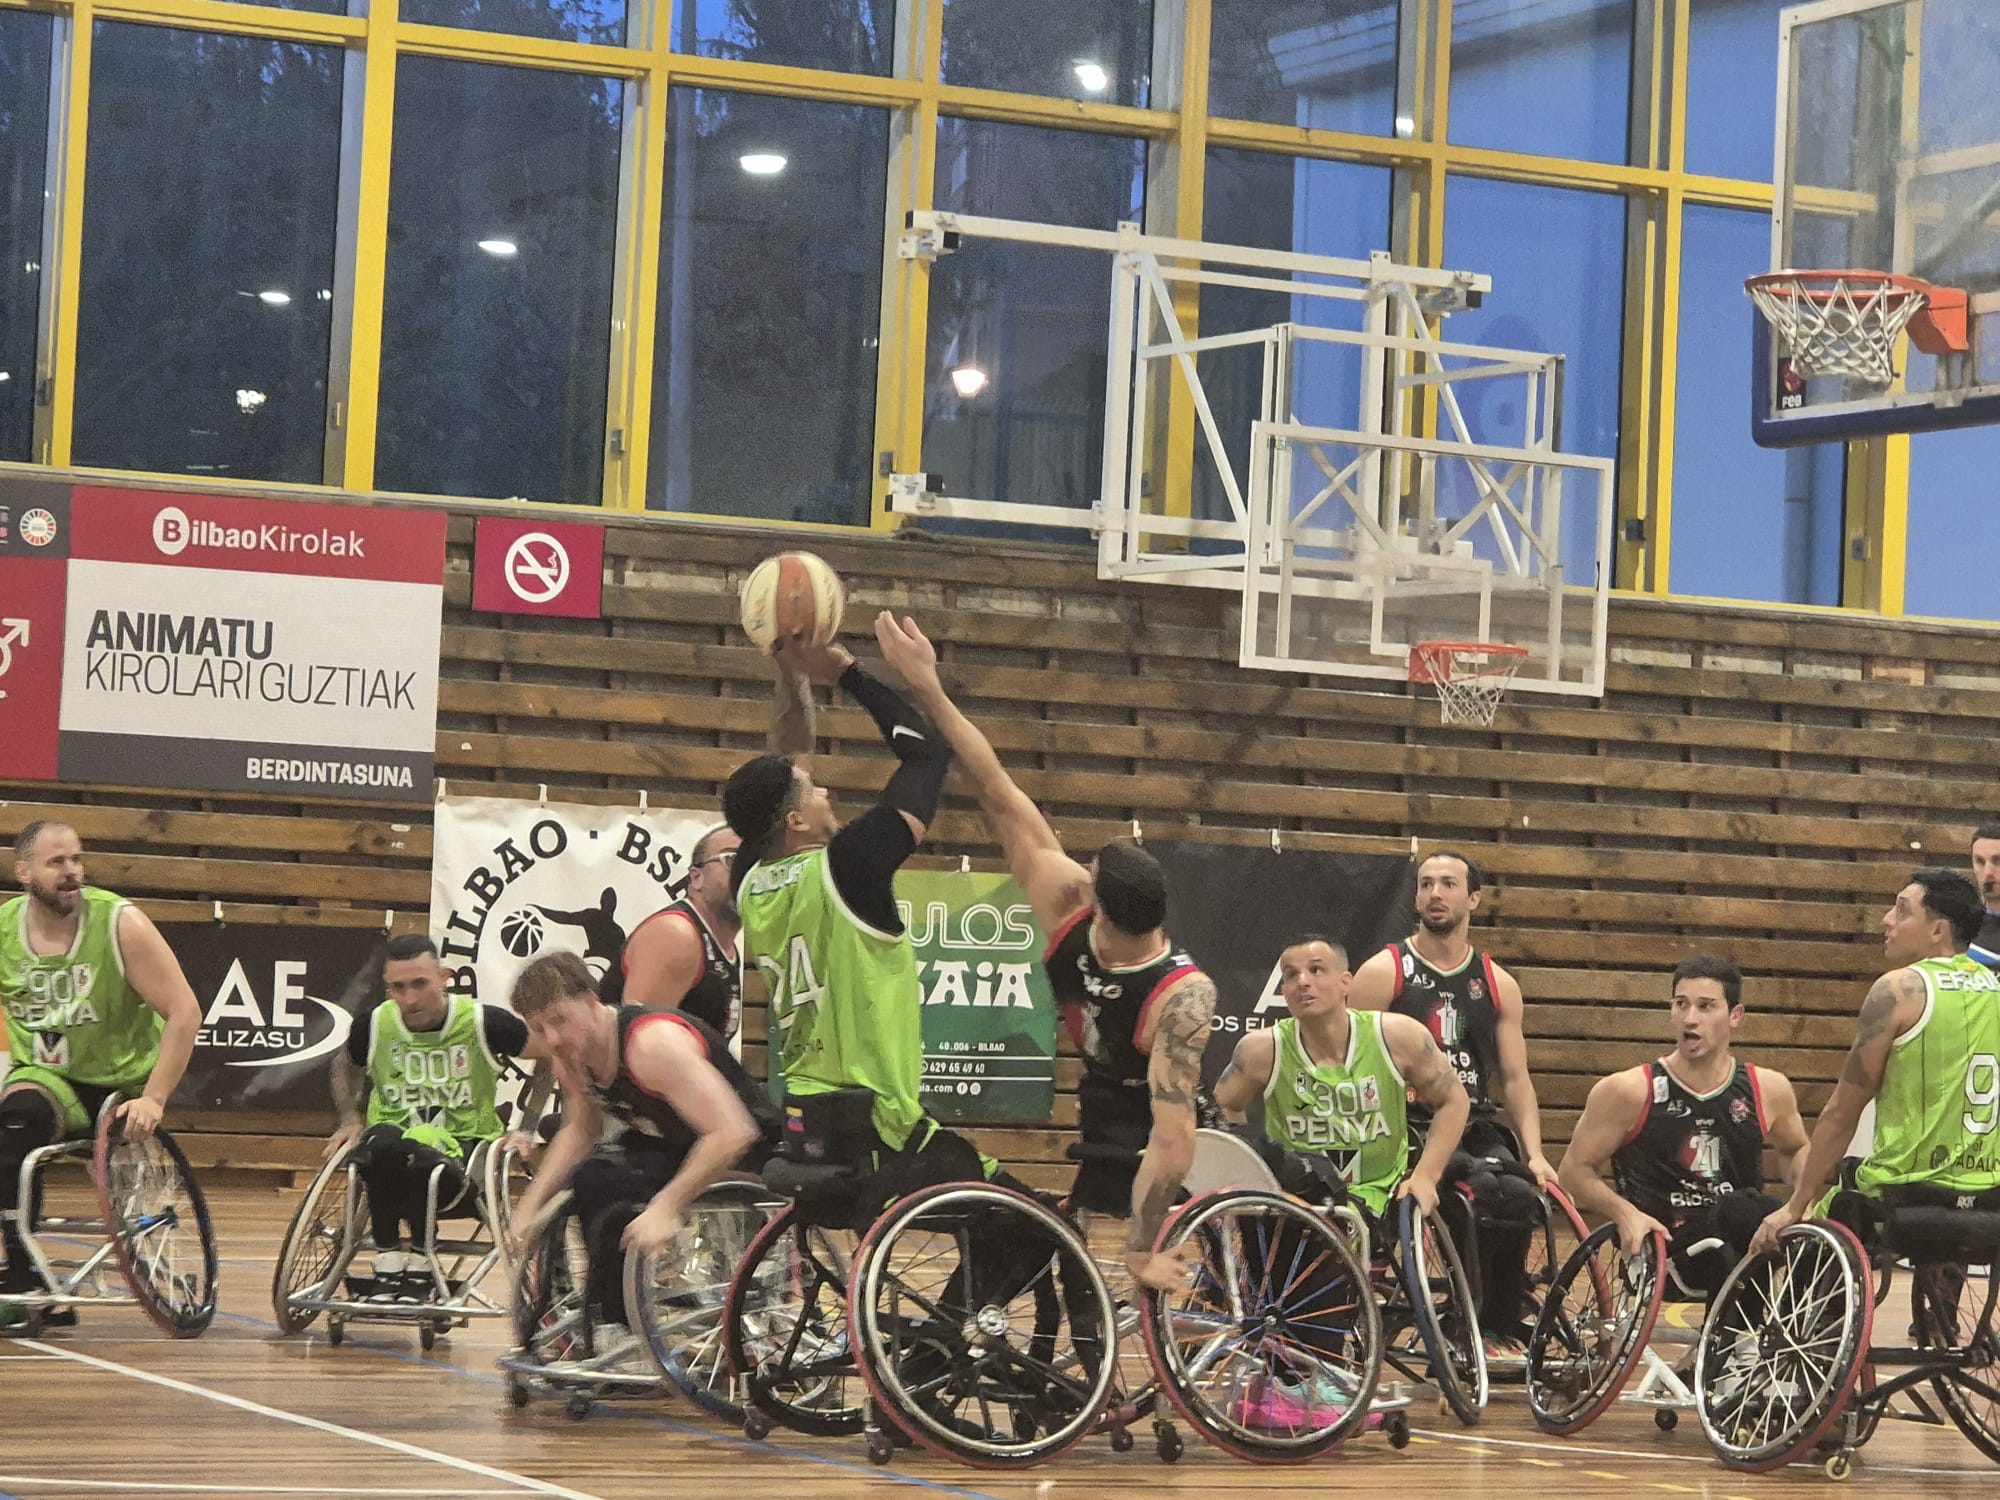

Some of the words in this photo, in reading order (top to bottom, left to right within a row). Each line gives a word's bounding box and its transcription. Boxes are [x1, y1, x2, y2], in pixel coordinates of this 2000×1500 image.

[86, 609, 273, 660] ANIMATU
[85, 651, 250, 700] KIROLARI
[259, 662, 416, 710] GUZTIAK
[246, 757, 414, 789] BERDINTASUNA
[440, 819, 568, 999] BILBAO
[203, 957, 307, 1028] AE
[195, 1029, 304, 1049] ELIZASU
[929, 1062, 946, 1073] 629
[1312, 1081, 1360, 1117] 30
[1962, 1053, 2000, 1135] 9
[1286, 1111, 1392, 1143] PENYA
[1689, 1134, 1721, 1172] 21
